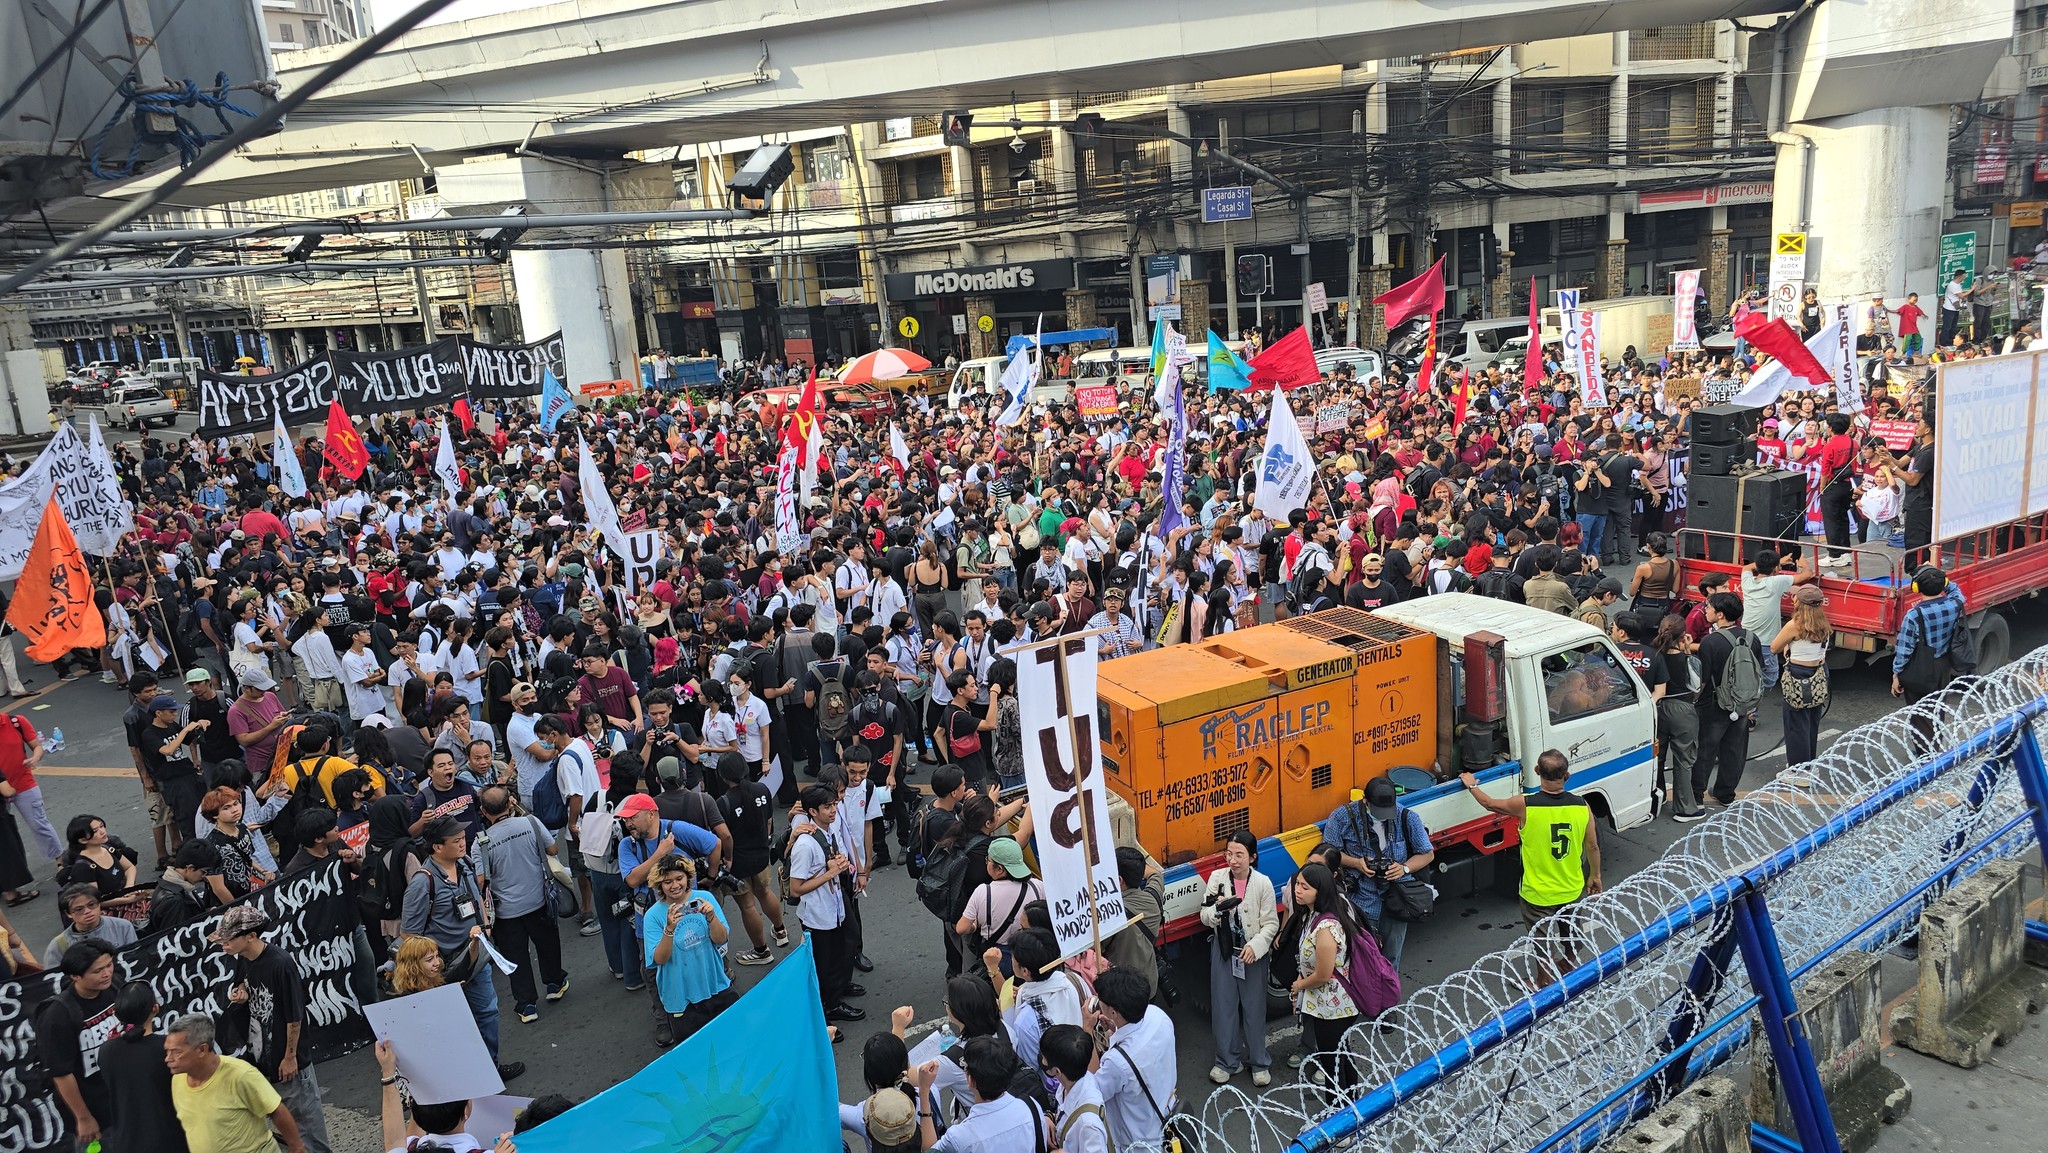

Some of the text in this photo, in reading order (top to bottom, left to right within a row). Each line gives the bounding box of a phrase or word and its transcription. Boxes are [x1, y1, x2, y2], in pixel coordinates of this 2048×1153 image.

[1207, 189, 1244, 203] Legarda St
[1721, 183, 1774, 198] mercury
[1217, 201, 1244, 212] Casal St
[915, 266, 1034, 295] McDonald's
[1677, 272, 1697, 341] CEU
[1779, 304, 1794, 312] NO
[1560, 291, 1578, 350] NTC
[1837, 305, 1853, 391] EARIST
[1080, 390, 1091, 399] NO
[1320, 402, 1348, 412] MARCOS
[1320, 411, 1347, 422] DUTERTE
[50, 454, 76, 483] ANG
[83, 521, 103, 534] THE
[630, 534, 654, 597] UP
[1297, 644, 1403, 684] GENERATOR RENTALS
[1376, 675, 1410, 690] POWER UNIT
[1389, 696, 1395, 712] 1
[1235, 700, 1331, 750] RACLEP
[1309, 724, 1334, 737] RENTAL
[1372, 730, 1420, 756] 0919-5501191
[735, 795, 767, 818] PSS
[1165, 783, 1246, 823] 216-6587/400-8916
[1550, 823, 1572, 862] 5
[1177, 882, 1198, 898] HIRE
[157, 899, 266, 968] ACTIN
[274, 859, 344, 918] NOW!
